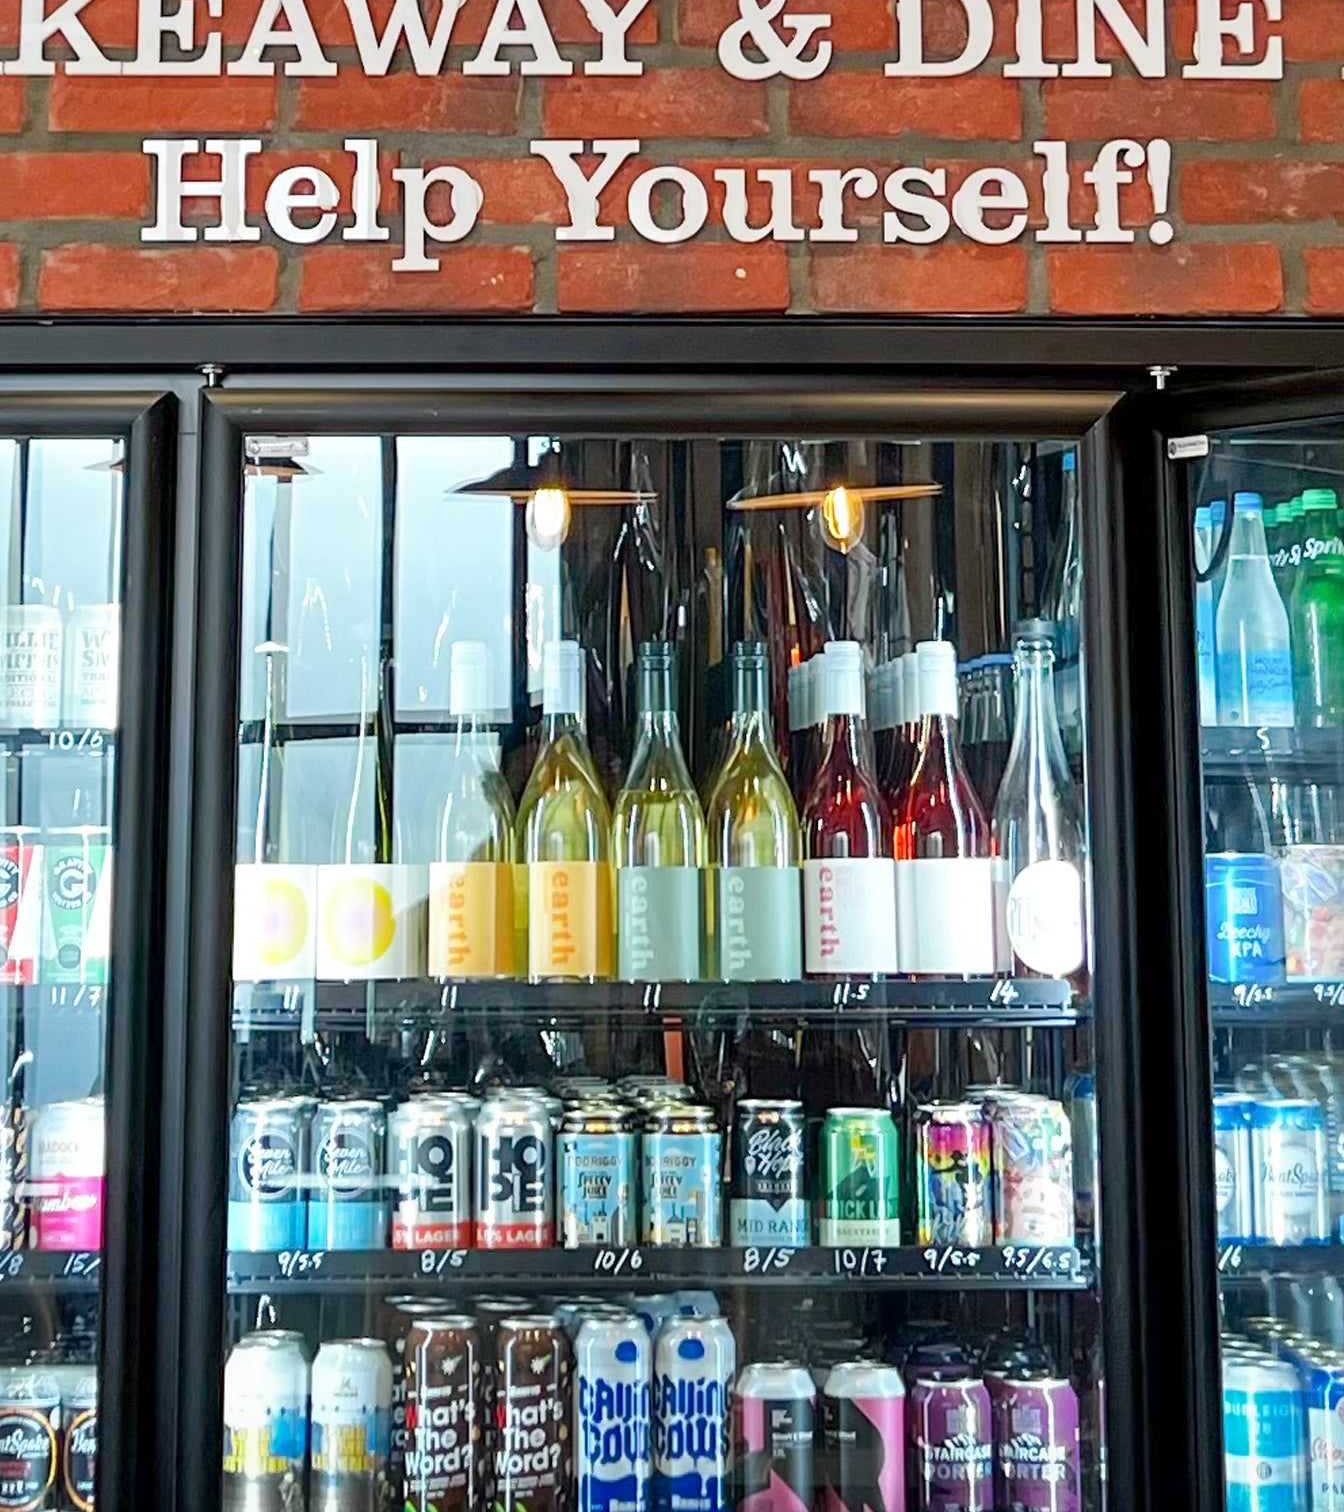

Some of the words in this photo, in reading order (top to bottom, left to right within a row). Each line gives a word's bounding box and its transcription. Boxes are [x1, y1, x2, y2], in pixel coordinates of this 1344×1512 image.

[141, 139, 484, 272] Help
[530, 138, 1174, 245] Yourself!
[49, 728, 103, 751] 10/6
[551, 870, 575, 966] earth
[630, 875, 655, 972] earth
[727, 875, 752, 972] earth
[818, 866, 841, 959] earth
[736, 1219, 764, 1234] MID
[594, 1248, 643, 1275] 10/6
[743, 1246, 795, 1273] 8/5
[834, 1246, 887, 1275] 10/7
[414, 1427, 457, 1453] The
[503, 1427, 547, 1453] The
[405, 1442, 474, 1478] Word?
